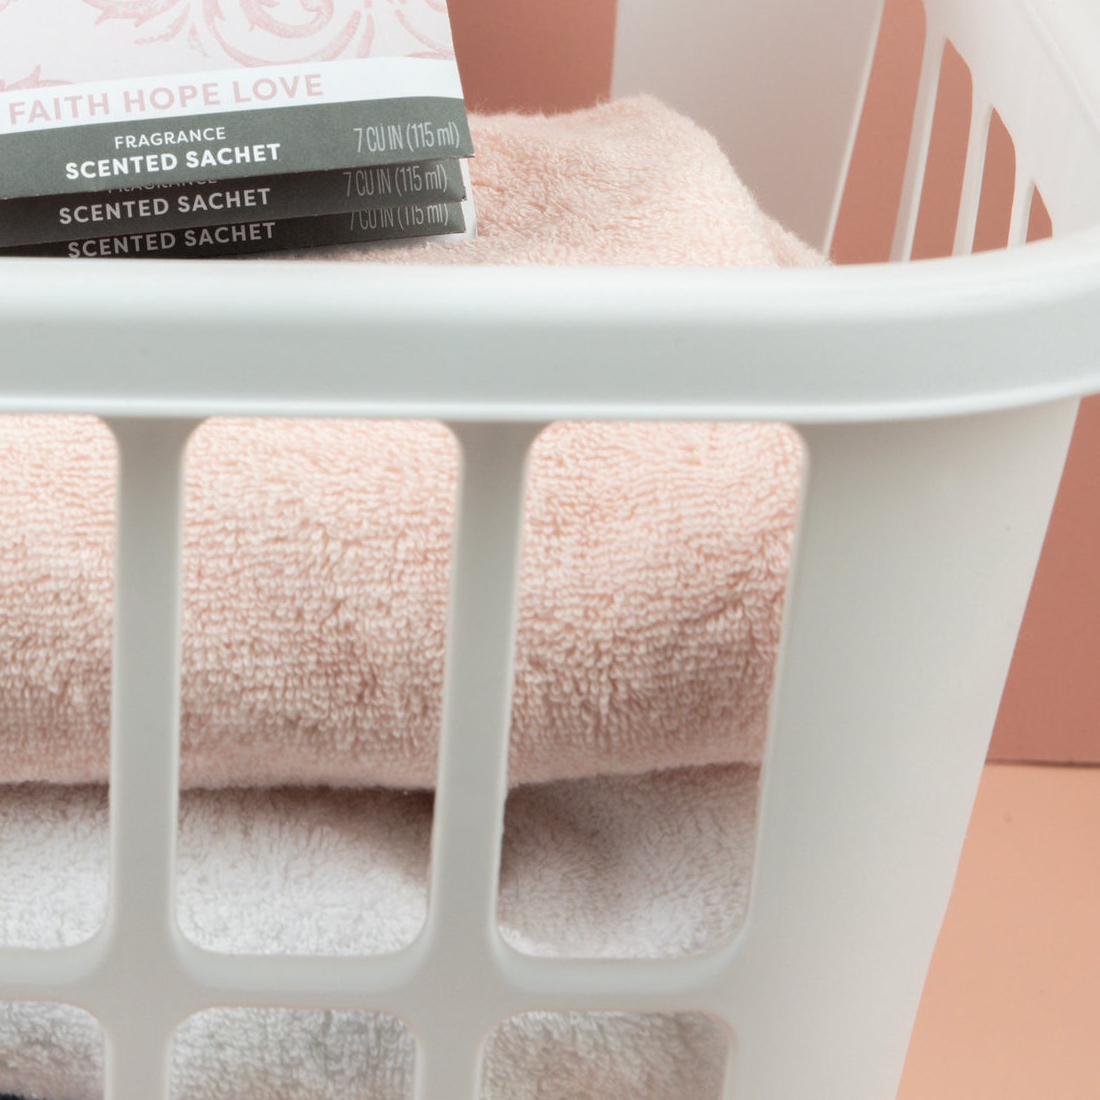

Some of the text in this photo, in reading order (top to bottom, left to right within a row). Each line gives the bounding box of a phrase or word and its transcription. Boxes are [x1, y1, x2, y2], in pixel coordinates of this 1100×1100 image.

[8, 74, 325, 125] FAITH HOPE LOVE
[114, 126, 227, 149] FRAGRANCE
[353, 121, 460, 152] 7 CU IN (115 ml)
[65, 143, 281, 180] SCENTED SACHET
[343, 164, 448, 197] 7 CU IN (115 ml)
[59, 188, 271, 225] SCENTED SACHET
[68, 221, 276, 259] SCENTED SACHET
